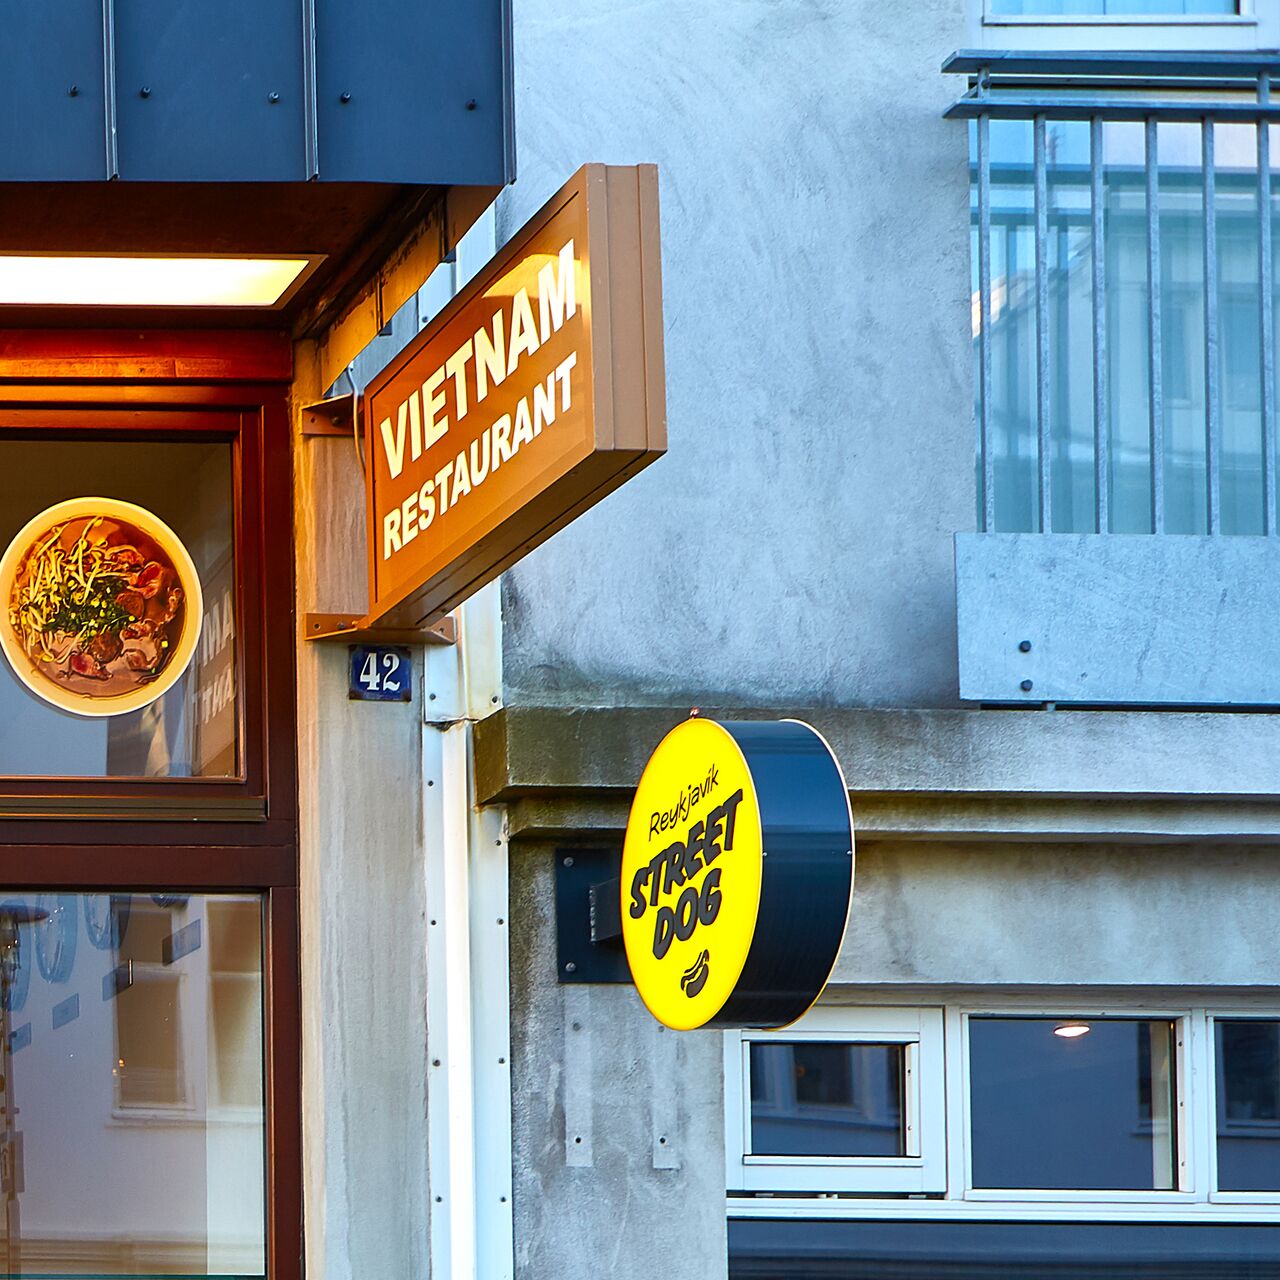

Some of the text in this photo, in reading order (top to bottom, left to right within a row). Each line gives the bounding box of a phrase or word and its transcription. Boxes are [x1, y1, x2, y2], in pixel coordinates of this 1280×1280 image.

[380, 239, 576, 480] VIETNAM
[383, 351, 577, 560] RESTAURANT
[359, 652, 401, 692] 42
[629, 788, 744, 919] STREET
[648, 763, 719, 842] Reykjavík
[652, 867, 723, 961] DOG
